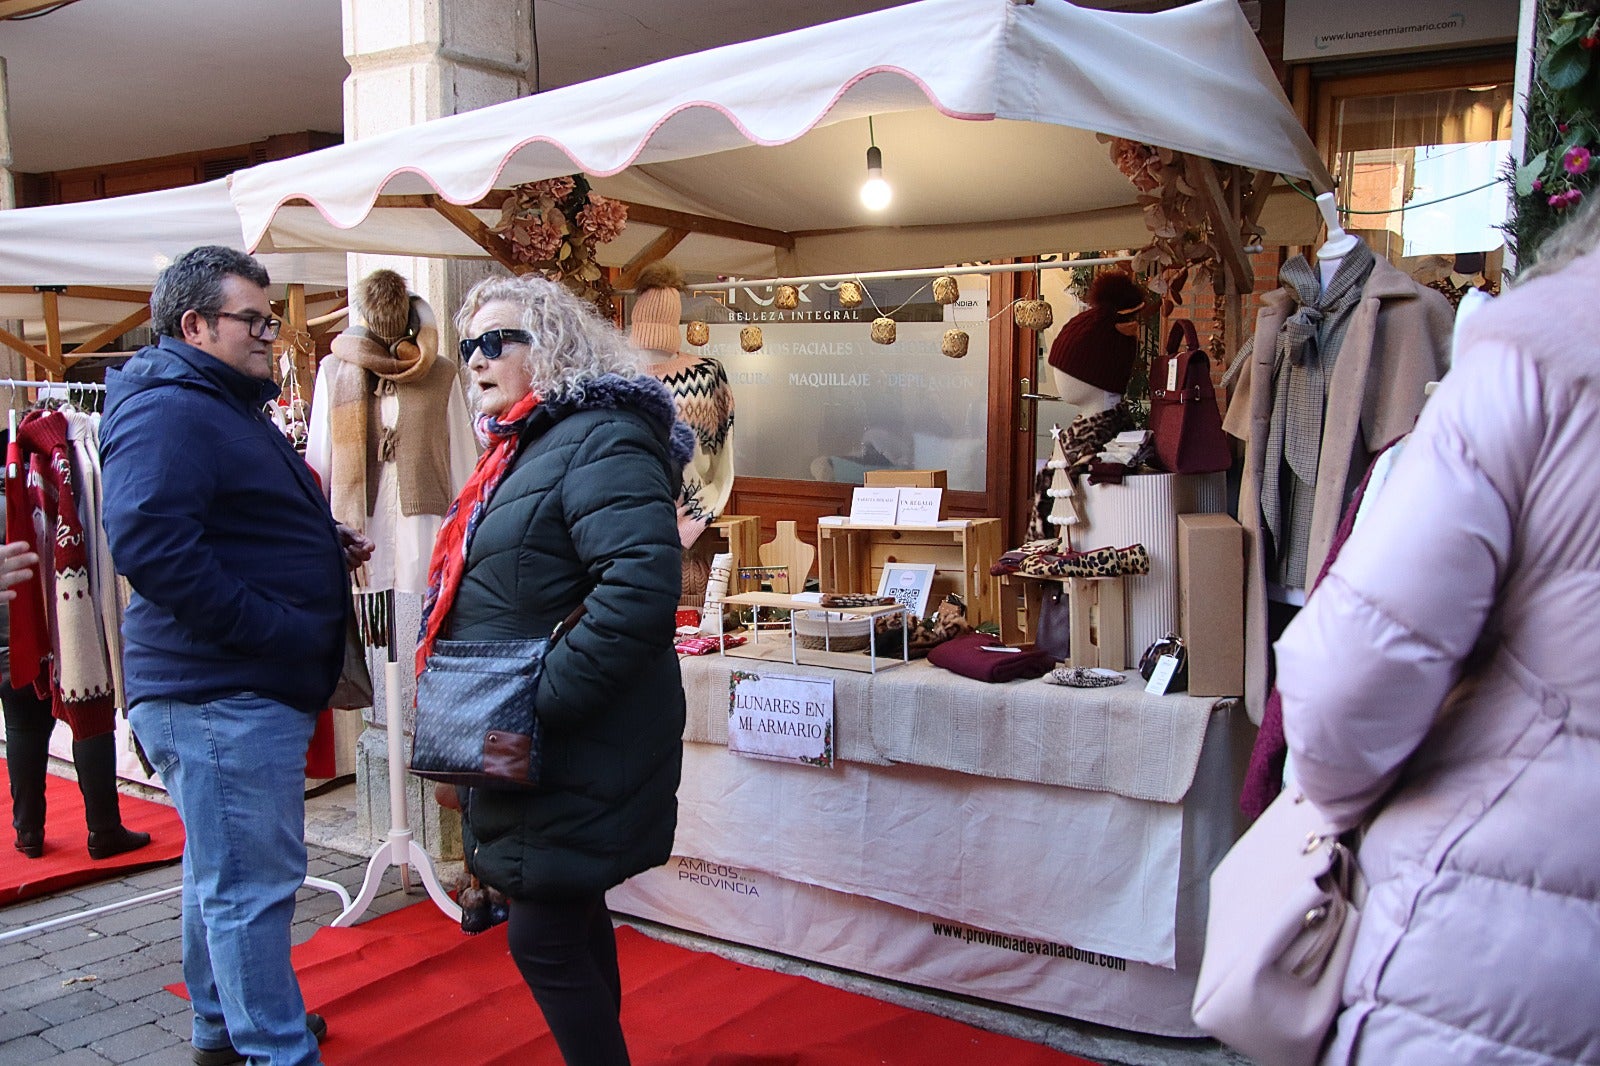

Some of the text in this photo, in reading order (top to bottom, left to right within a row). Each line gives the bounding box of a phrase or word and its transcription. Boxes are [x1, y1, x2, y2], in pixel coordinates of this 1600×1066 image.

[1321, 19, 1457, 43] www.lunaresenmiarmario.com
[728, 310, 860, 322] BELLEZA INTEGRAL
[793, 342, 853, 356] FACIALES
[789, 372, 871, 388] MAQUILLAJE
[737, 694, 825, 718] LUNARES EN
[738, 716, 822, 739] MI ARMARIO
[678, 858, 738, 879] AMIGOS
[678, 870, 760, 898] PROVINCIA
